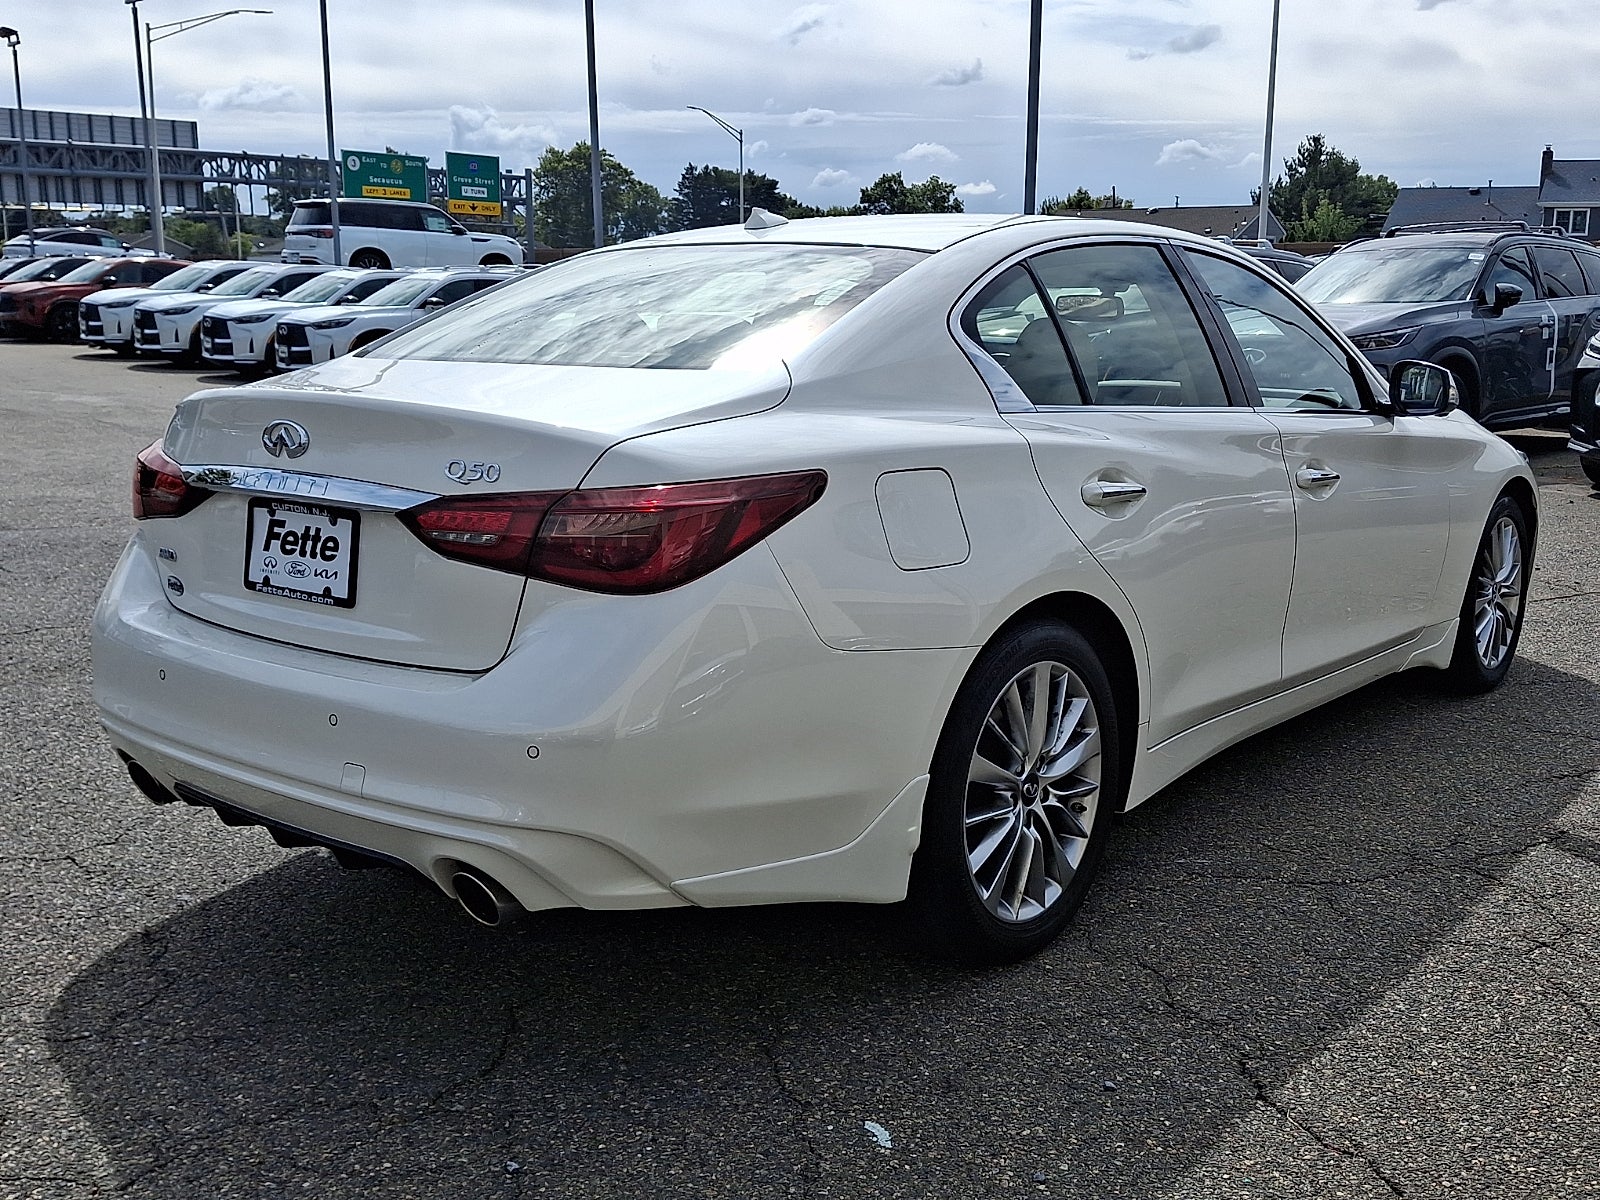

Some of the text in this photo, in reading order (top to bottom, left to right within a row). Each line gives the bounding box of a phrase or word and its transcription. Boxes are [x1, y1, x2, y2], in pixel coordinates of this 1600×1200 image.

[369, 175, 403, 185] Secaucus
[453, 175, 495, 185] Grove Street
[444, 459, 500, 485] Q50
[312, 507, 331, 517] N.J.
[262, 518, 340, 562] Fette
[286, 562, 307, 577] Ford
[256, 583, 334, 605] FetteAuto.com
